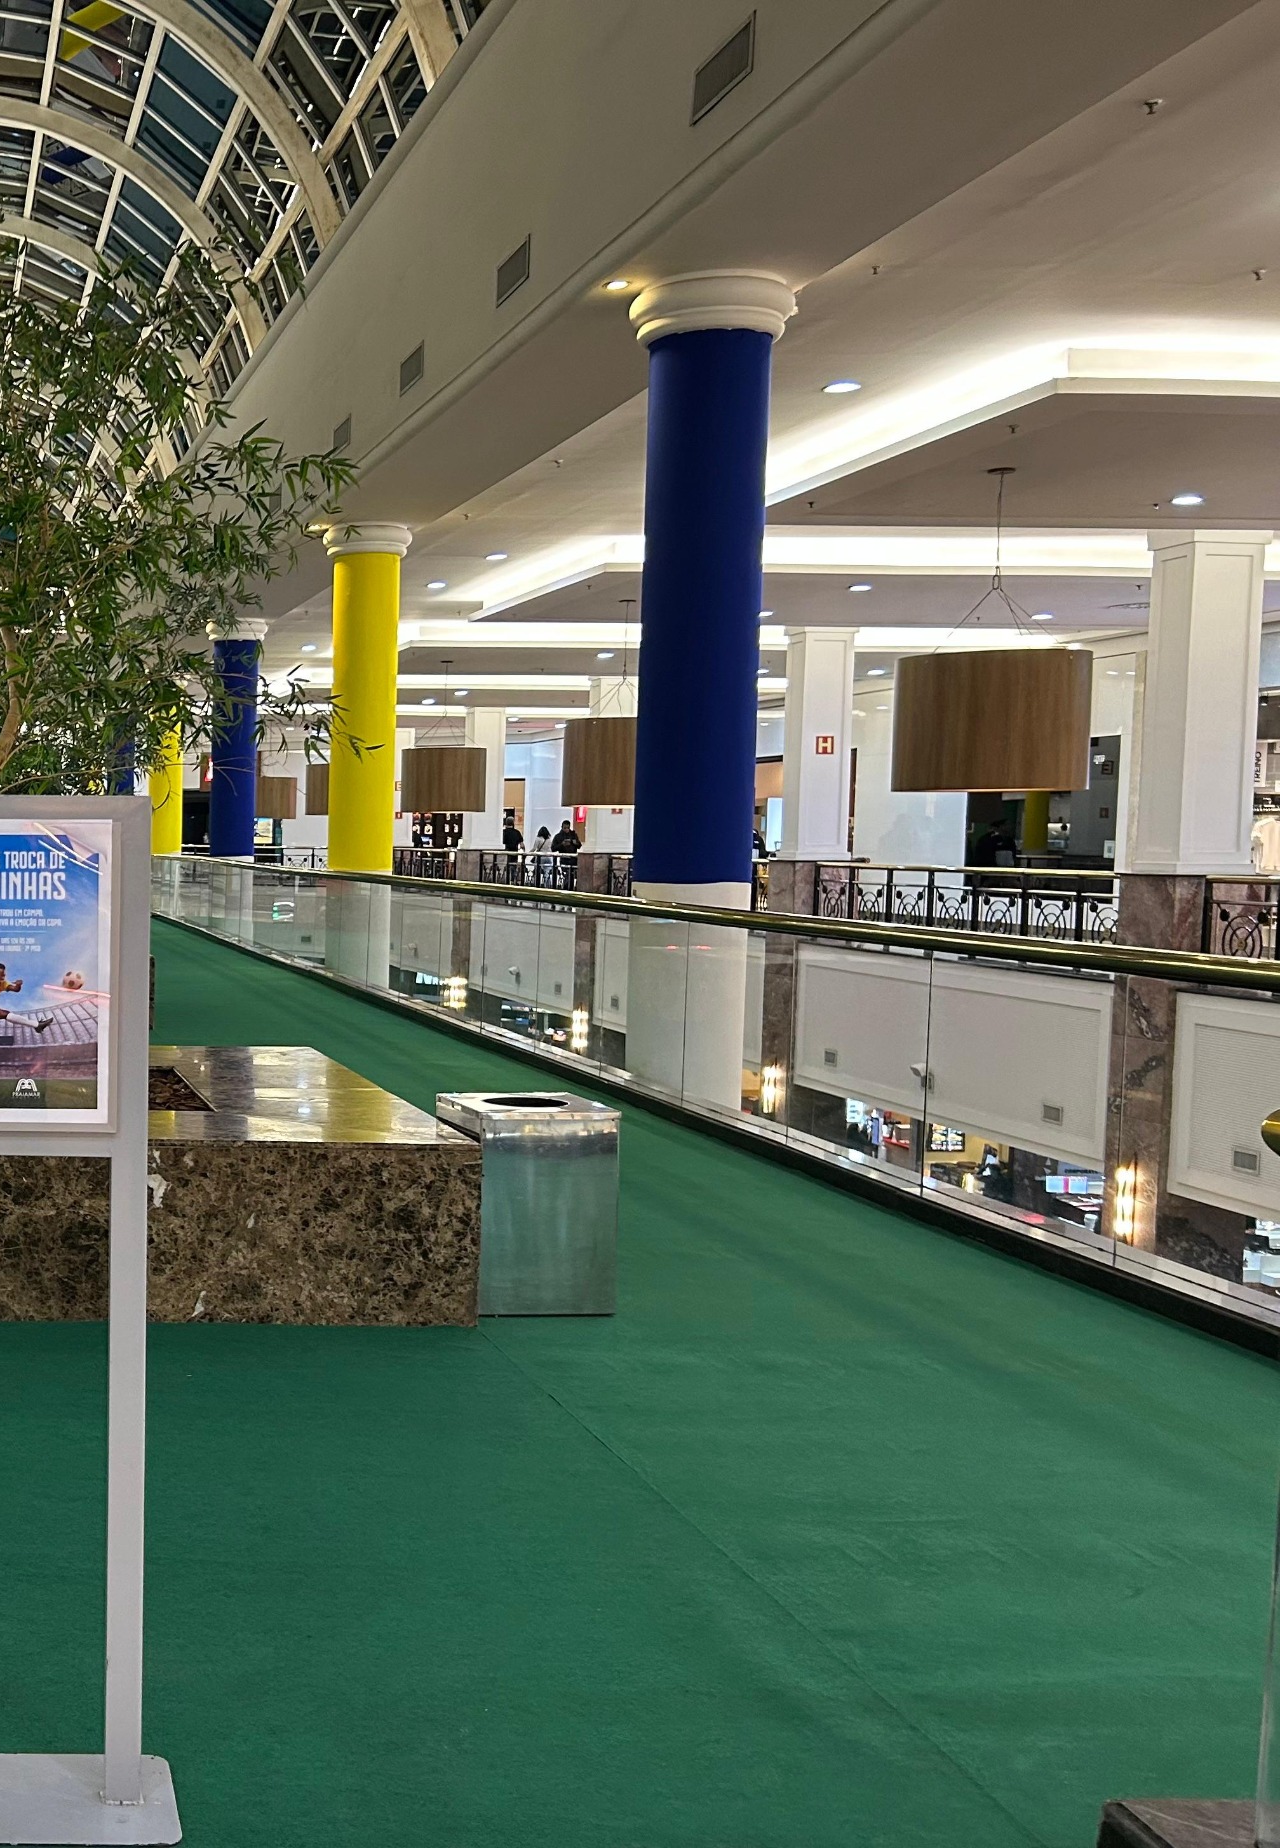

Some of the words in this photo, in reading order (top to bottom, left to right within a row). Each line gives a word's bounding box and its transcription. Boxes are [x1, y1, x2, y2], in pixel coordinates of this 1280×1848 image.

[818, 737, 832, 753] H
[4, 851, 45, 869] TROCA
[49, 851, 66, 869] DE
